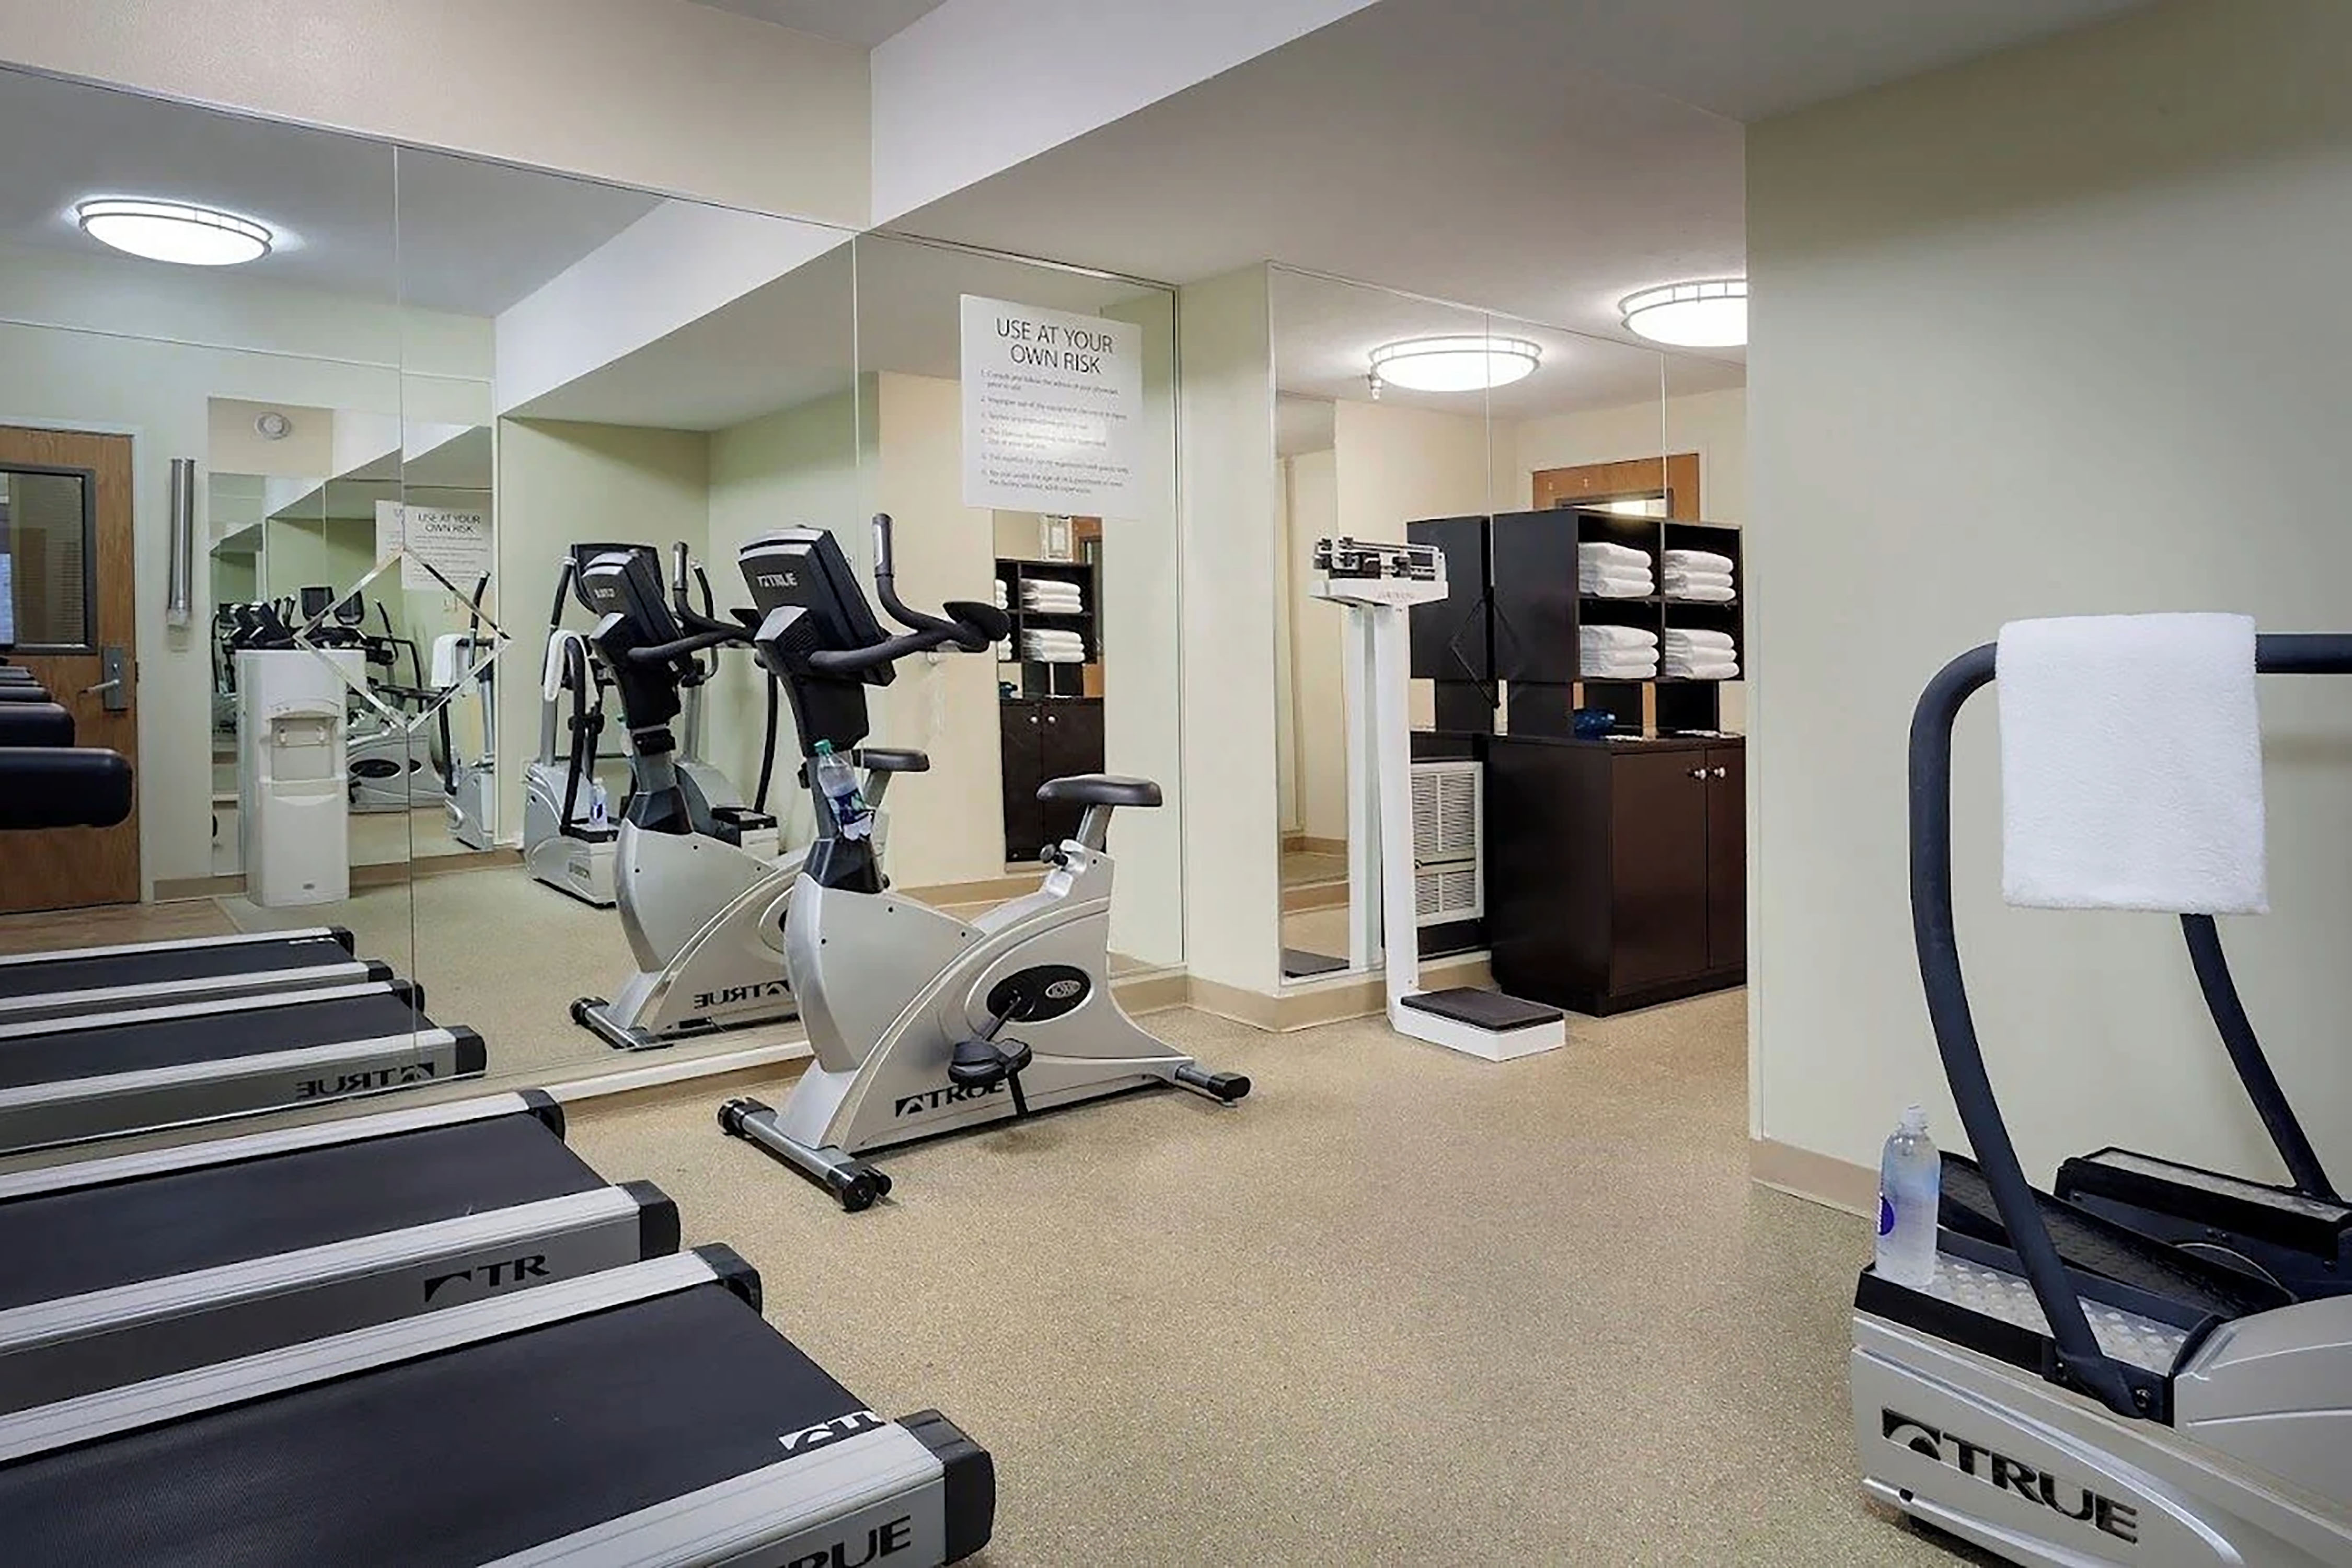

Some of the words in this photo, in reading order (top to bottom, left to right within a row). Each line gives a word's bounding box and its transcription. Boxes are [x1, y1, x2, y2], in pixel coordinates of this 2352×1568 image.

[996, 318, 1031, 340] USE
[1037, 324, 1059, 344] AT
[1064, 327, 1113, 354] YOUR
[1010, 343, 1058, 368] OWN
[1064, 352, 1101, 375] RISK
[477, 1254, 550, 1287] TR
[1942, 1432, 2138, 1544] TRUE
